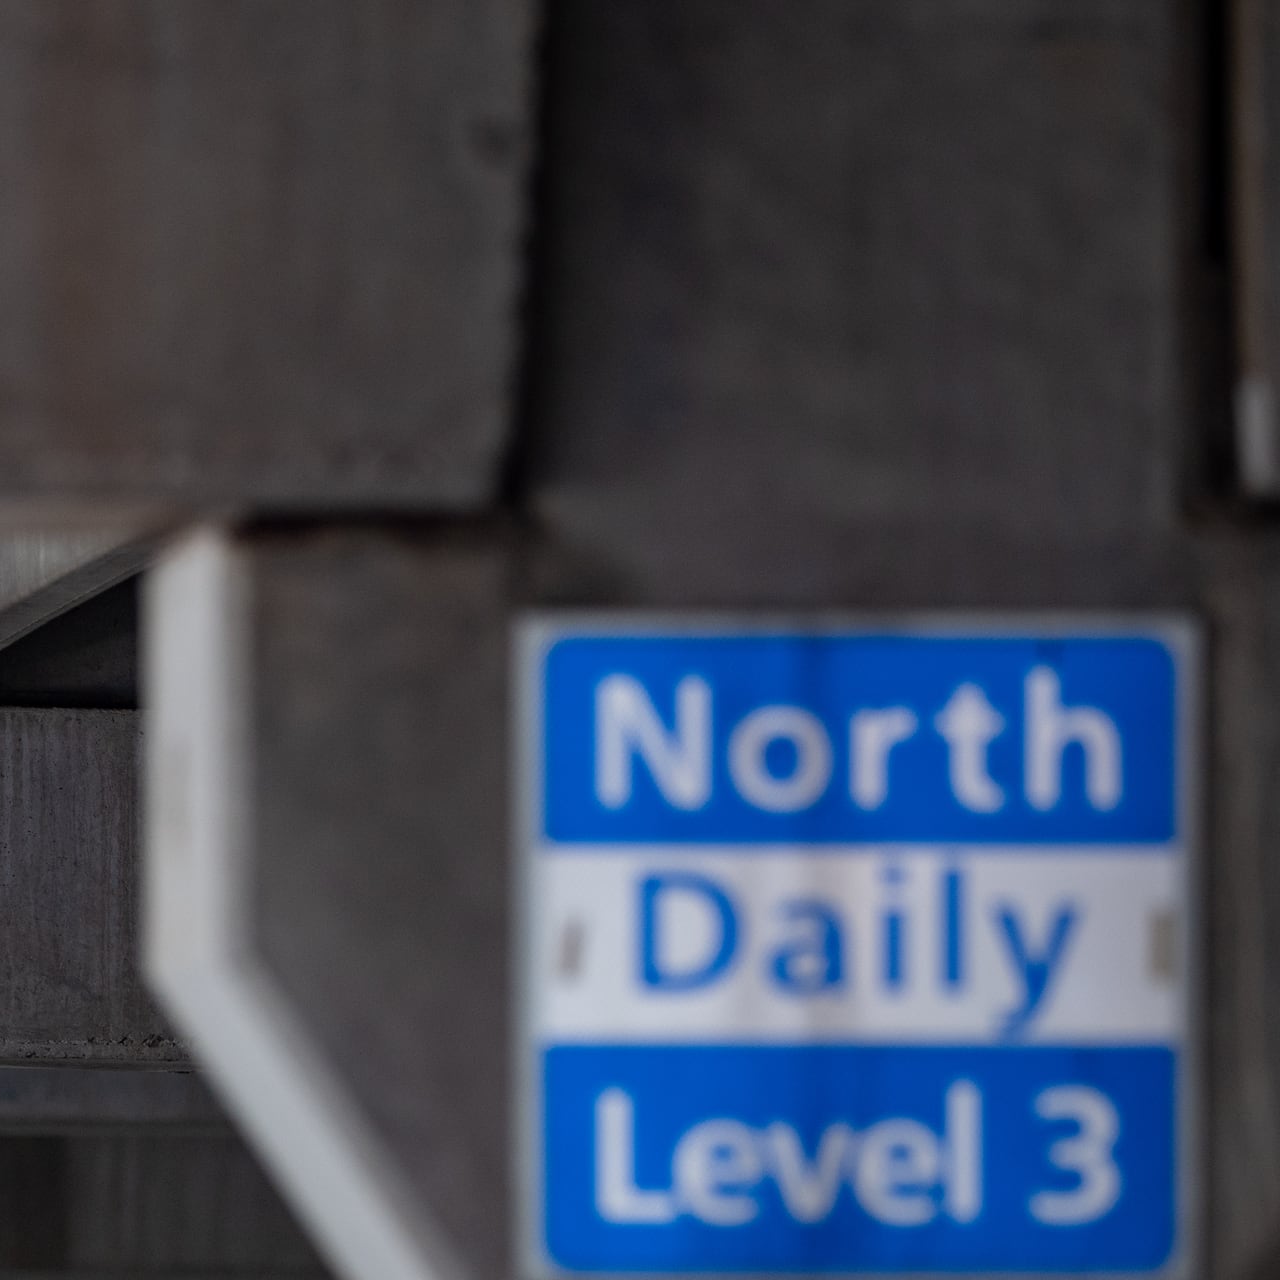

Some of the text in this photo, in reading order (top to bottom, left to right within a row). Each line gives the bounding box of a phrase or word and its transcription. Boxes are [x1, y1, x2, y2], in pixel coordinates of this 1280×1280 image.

[593, 667, 1123, 813] North
[634, 860, 1082, 1042] Daily
[593, 1080, 1122, 1226] Level 3
